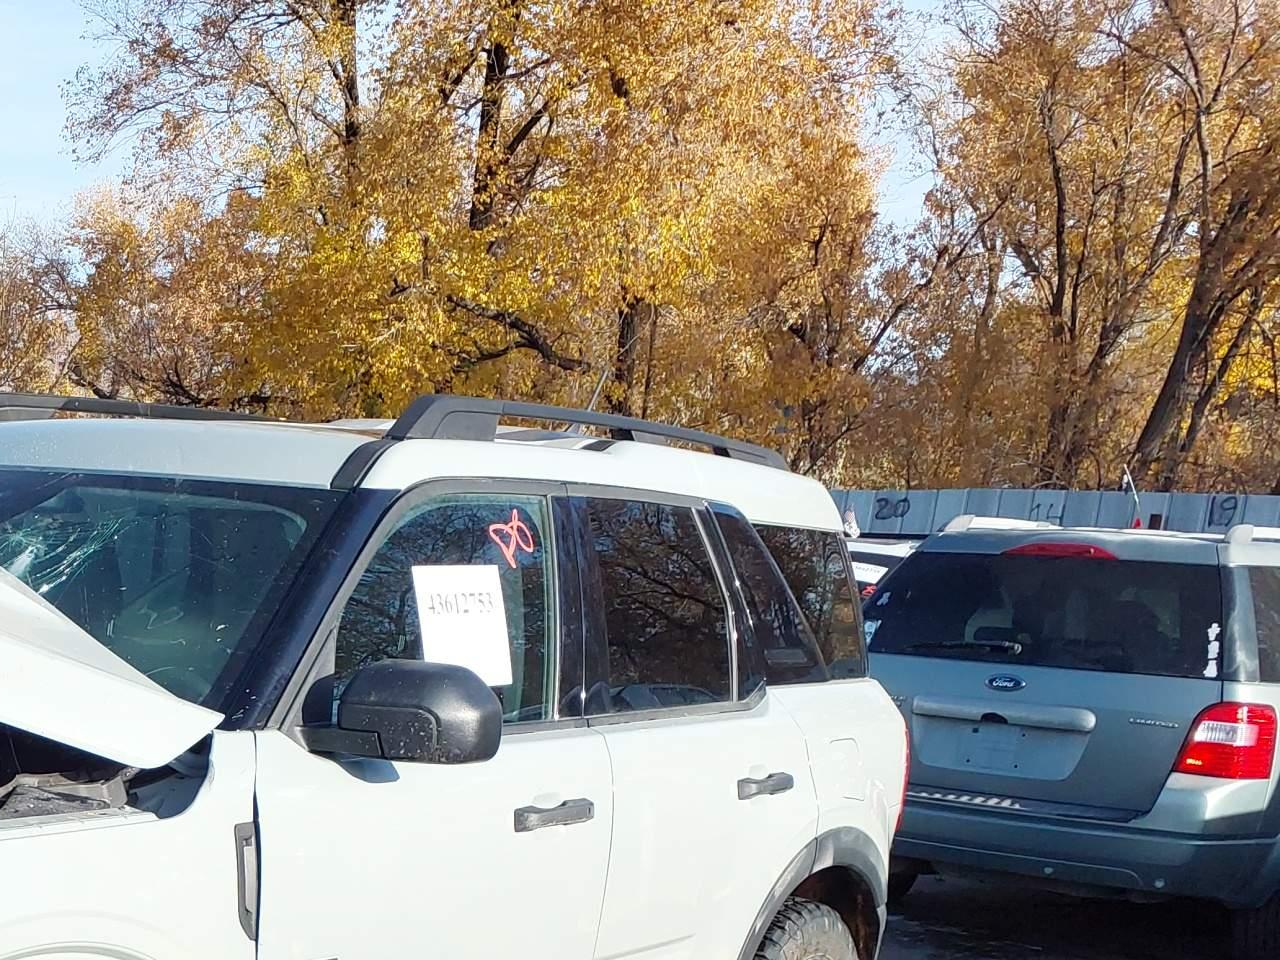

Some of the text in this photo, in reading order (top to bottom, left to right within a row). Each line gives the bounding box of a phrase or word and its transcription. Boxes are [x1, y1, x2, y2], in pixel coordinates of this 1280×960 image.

[874, 495, 911, 520] 20
[1207, 495, 1238, 527] 19
[427, 592, 494, 615] 43612753
